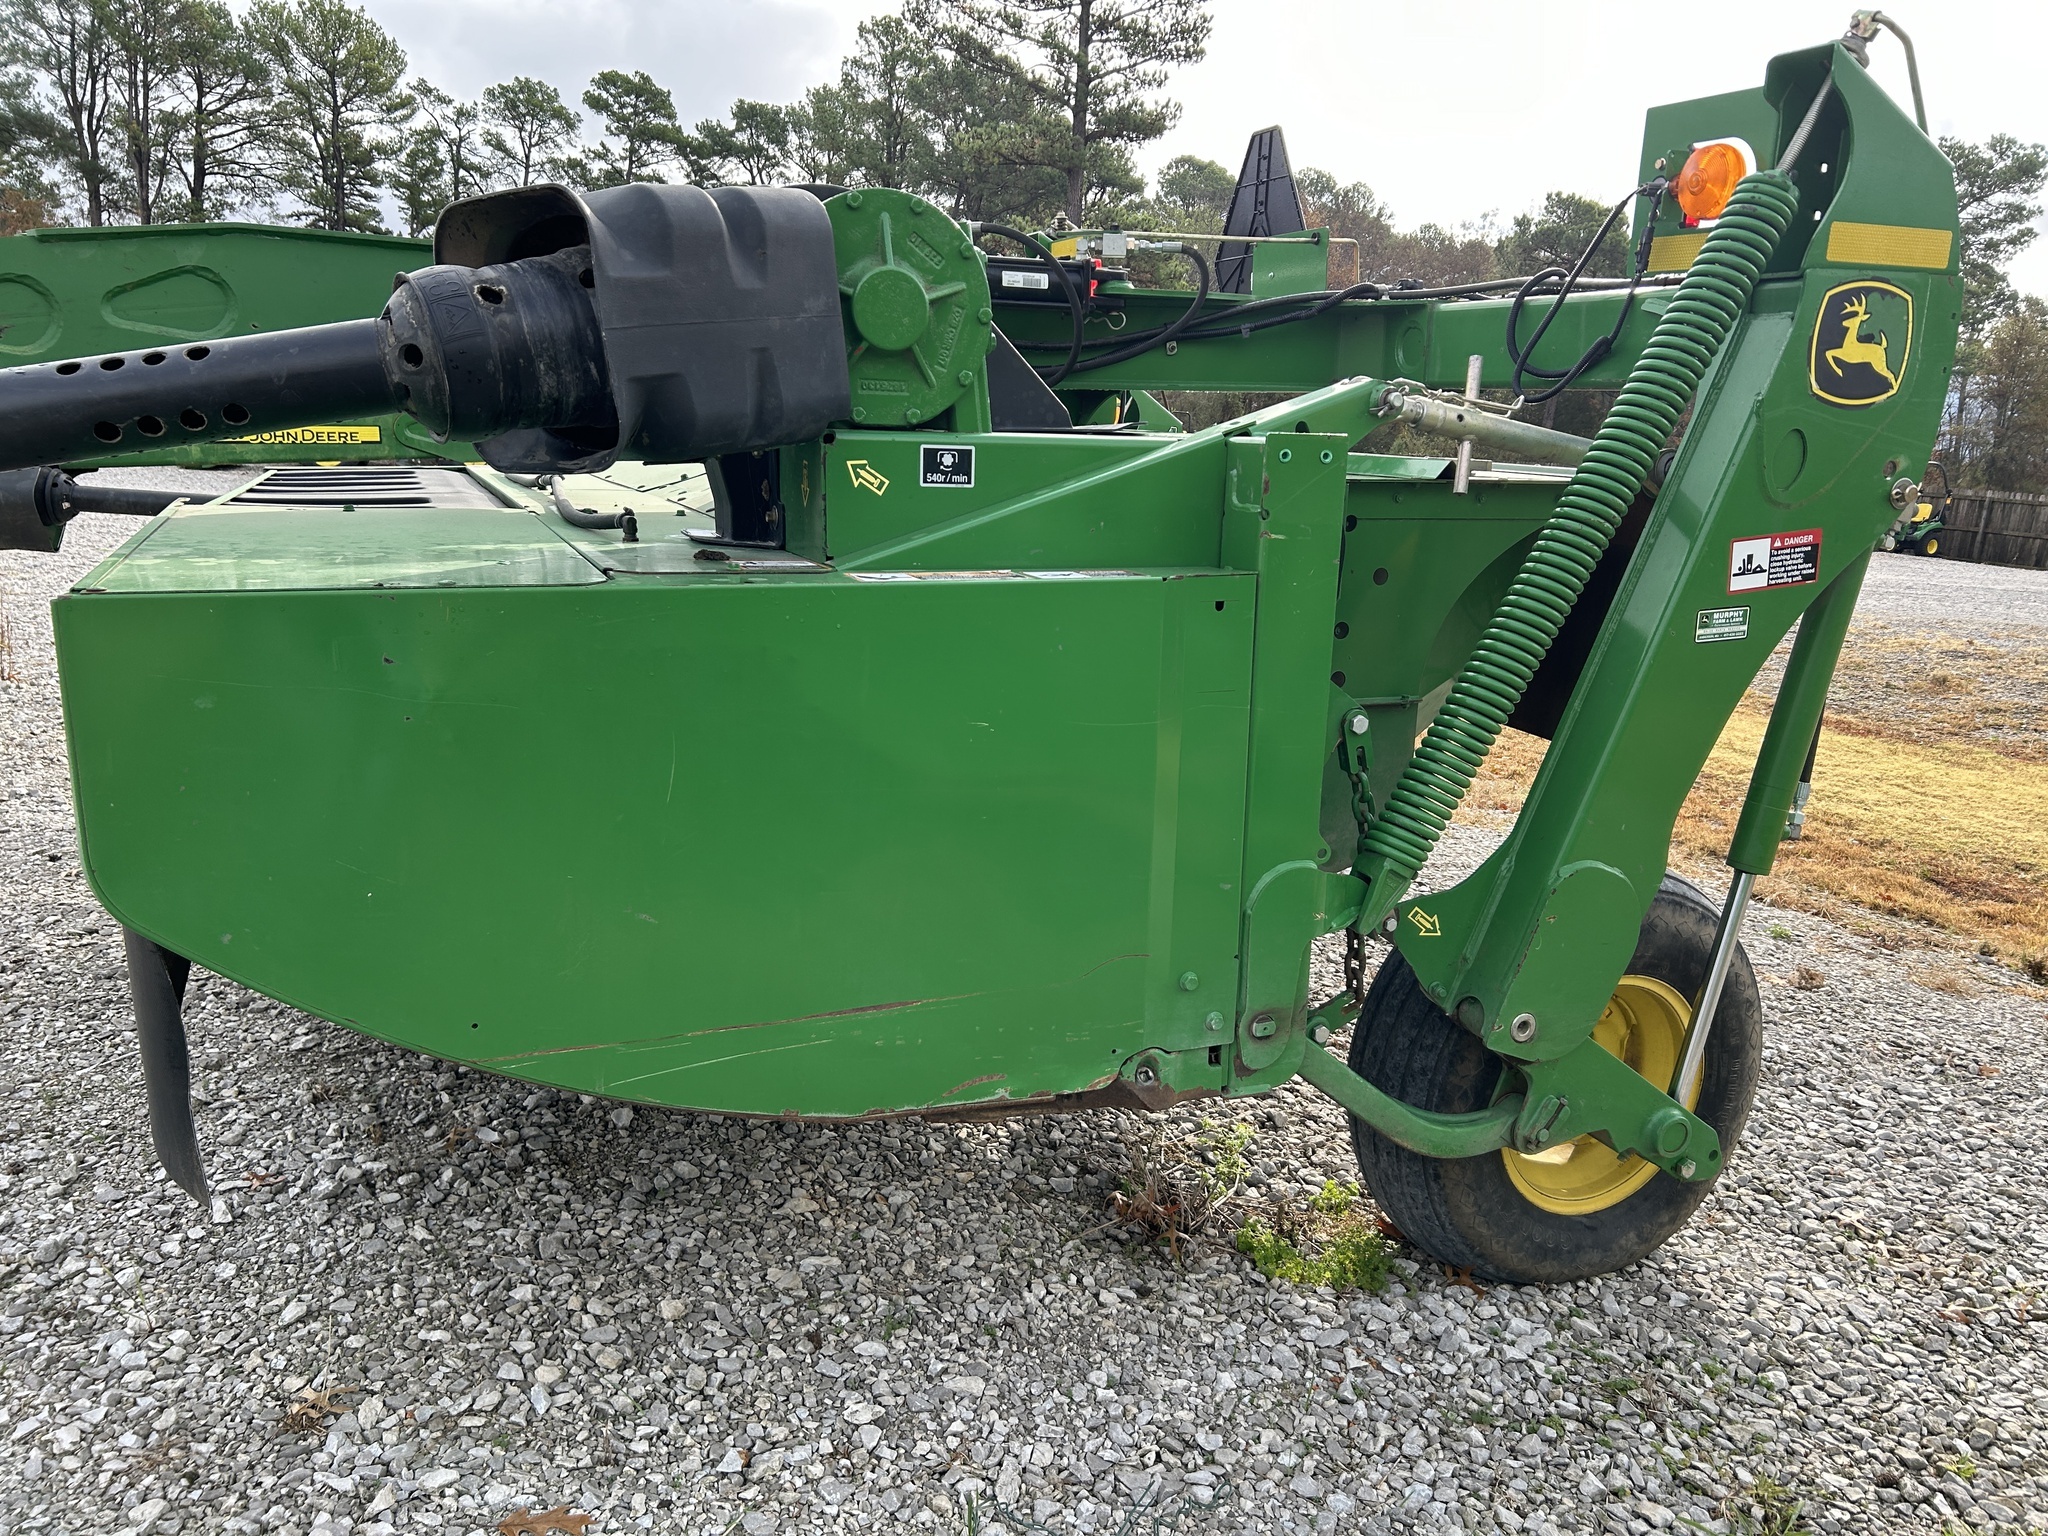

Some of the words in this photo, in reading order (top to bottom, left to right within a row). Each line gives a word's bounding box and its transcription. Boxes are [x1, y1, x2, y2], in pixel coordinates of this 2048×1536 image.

[250, 431, 299, 442] JOHN
[301, 429, 360, 442] DEERE
[926, 473, 945, 482] 540r
[952, 474, 968, 482] min
[1784, 535, 1813, 545] DANGER
